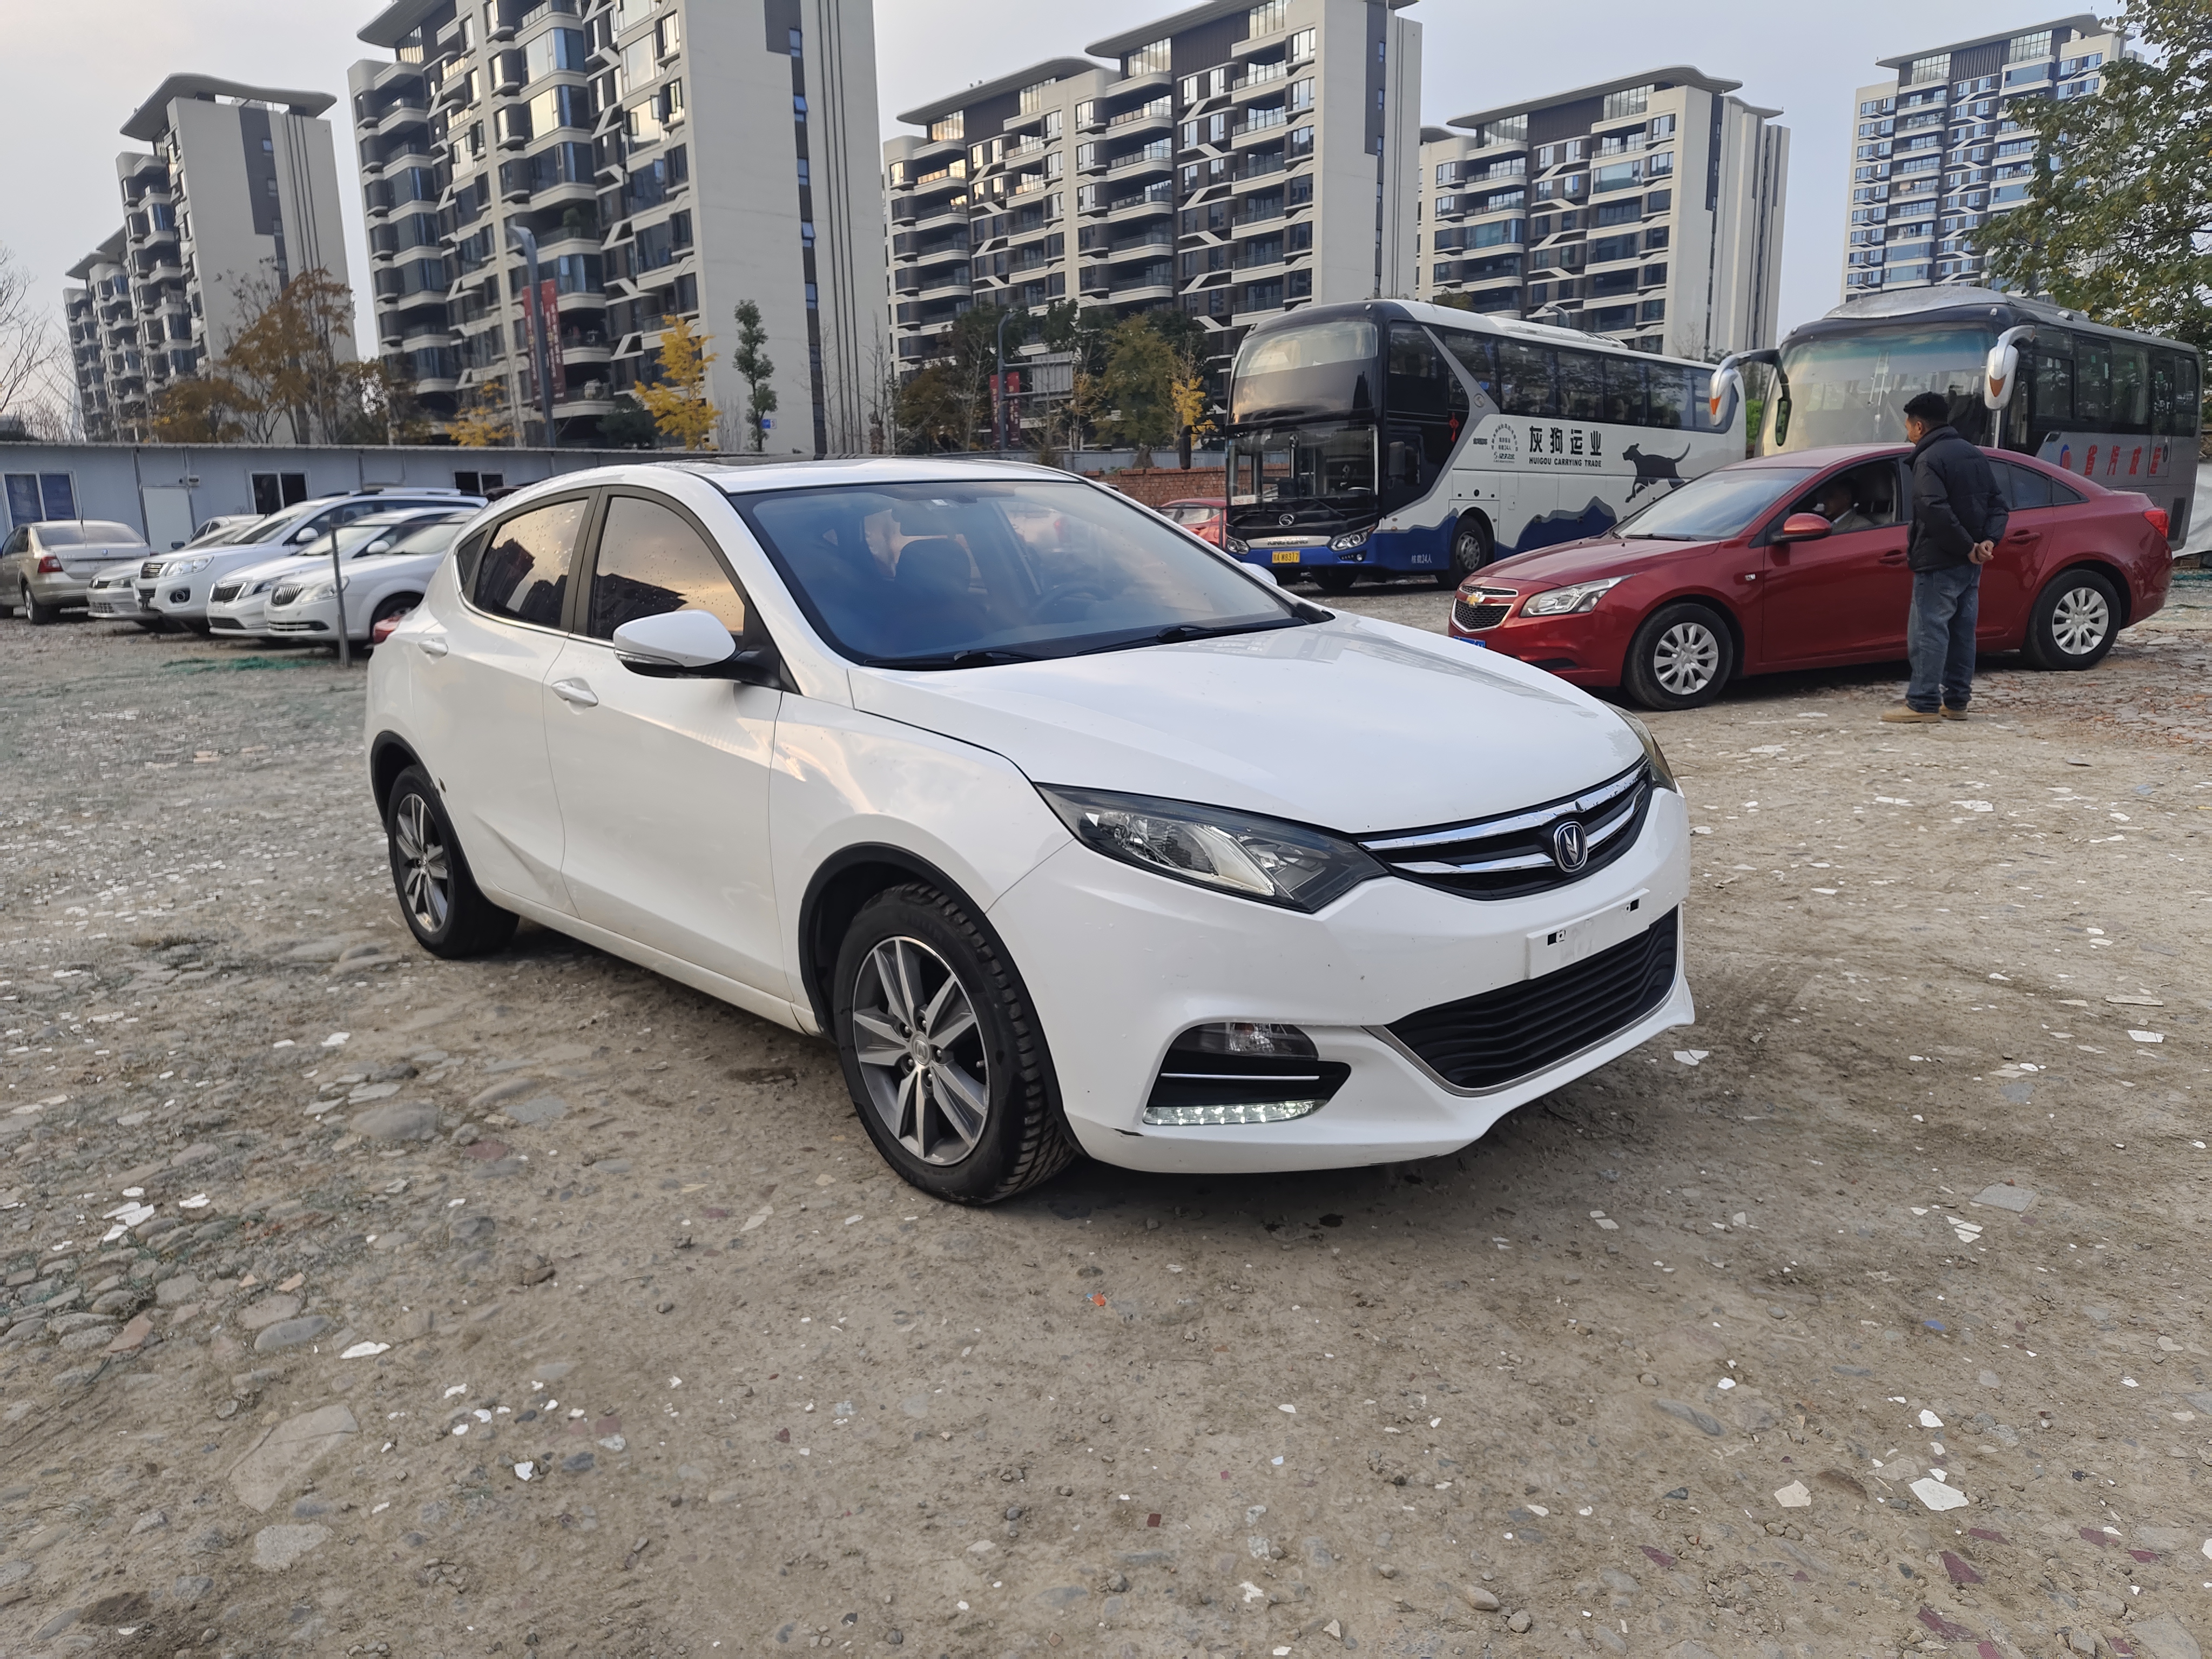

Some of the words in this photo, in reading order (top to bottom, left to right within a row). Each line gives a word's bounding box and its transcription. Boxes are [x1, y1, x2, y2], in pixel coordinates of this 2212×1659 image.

[1529, 425, 1602, 456] 灰狗运业
[1529, 457, 1552, 465] HUIGOU
[1554, 458, 1582, 466] CARRYING
